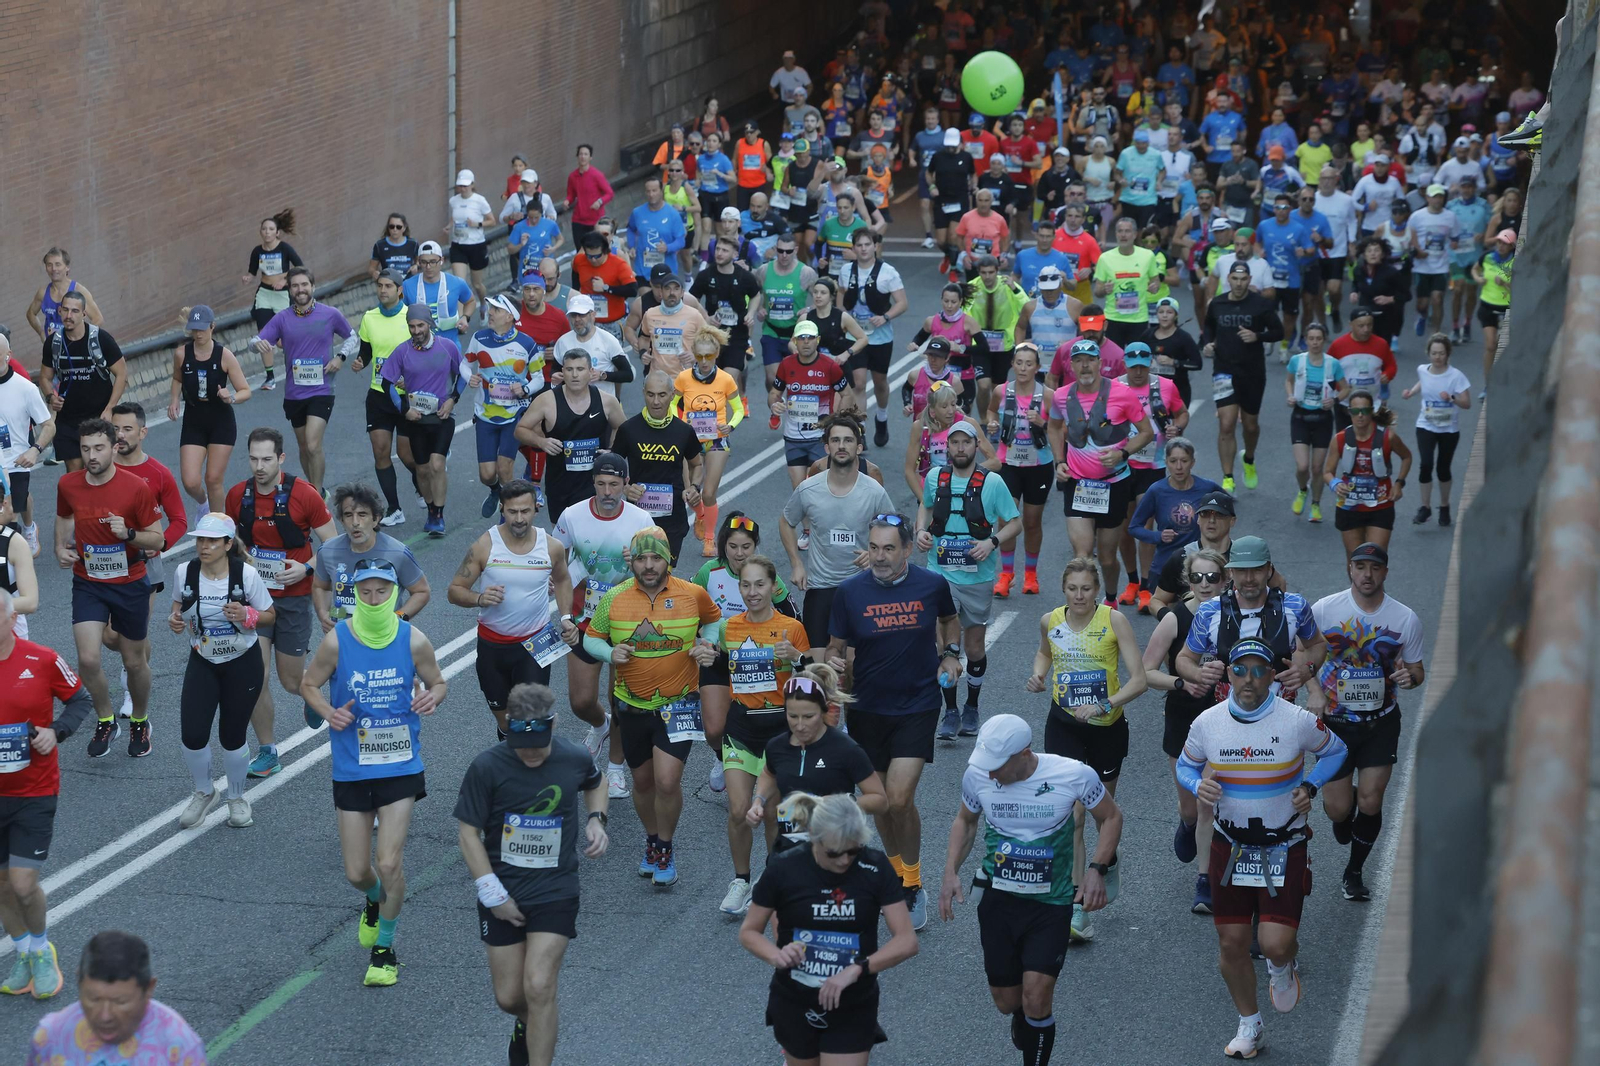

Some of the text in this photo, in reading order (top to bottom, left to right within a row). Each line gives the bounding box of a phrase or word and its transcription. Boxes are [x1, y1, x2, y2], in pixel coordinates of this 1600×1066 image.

[572, 456, 594, 464] MUÑIZ
[642, 454, 675, 462] ULTRA
[1074, 496, 1108, 504] STEWARTY
[833, 534, 854, 542] 11951
[258, 552, 282, 560] ZURICH
[89, 562, 123, 571] BASTIEN
[863, 600, 924, 616] STRAVA
[874, 614, 918, 628] WARS
[212, 647, 238, 656] ASMA
[742, 650, 768, 658] ZURICH
[368, 668, 396, 680] TEAM
[730, 671, 776, 682] MERCEDES
[1074, 673, 1100, 681] ZURICH
[368, 678, 404, 688] RUNNING
[1068, 695, 1098, 706] LAURA
[374, 718, 401, 726] ZURICH
[676, 720, 697, 731] RAÚL
[360, 740, 411, 753] FRANCISCO
[1220, 746, 1274, 758] IMPREXIONA
[524, 818, 556, 827] ZURICH
[508, 842, 553, 855] CHUBBY
[1015, 846, 1046, 856] ZURICH
[1012, 862, 1034, 870] 13645
[1236, 862, 1281, 875] GUSTVO
[1001, 868, 1044, 882] CLAUDE
[812, 904, 856, 916] TEAM
[816, 934, 853, 945] ZURICH
[813, 951, 838, 962] 14356
